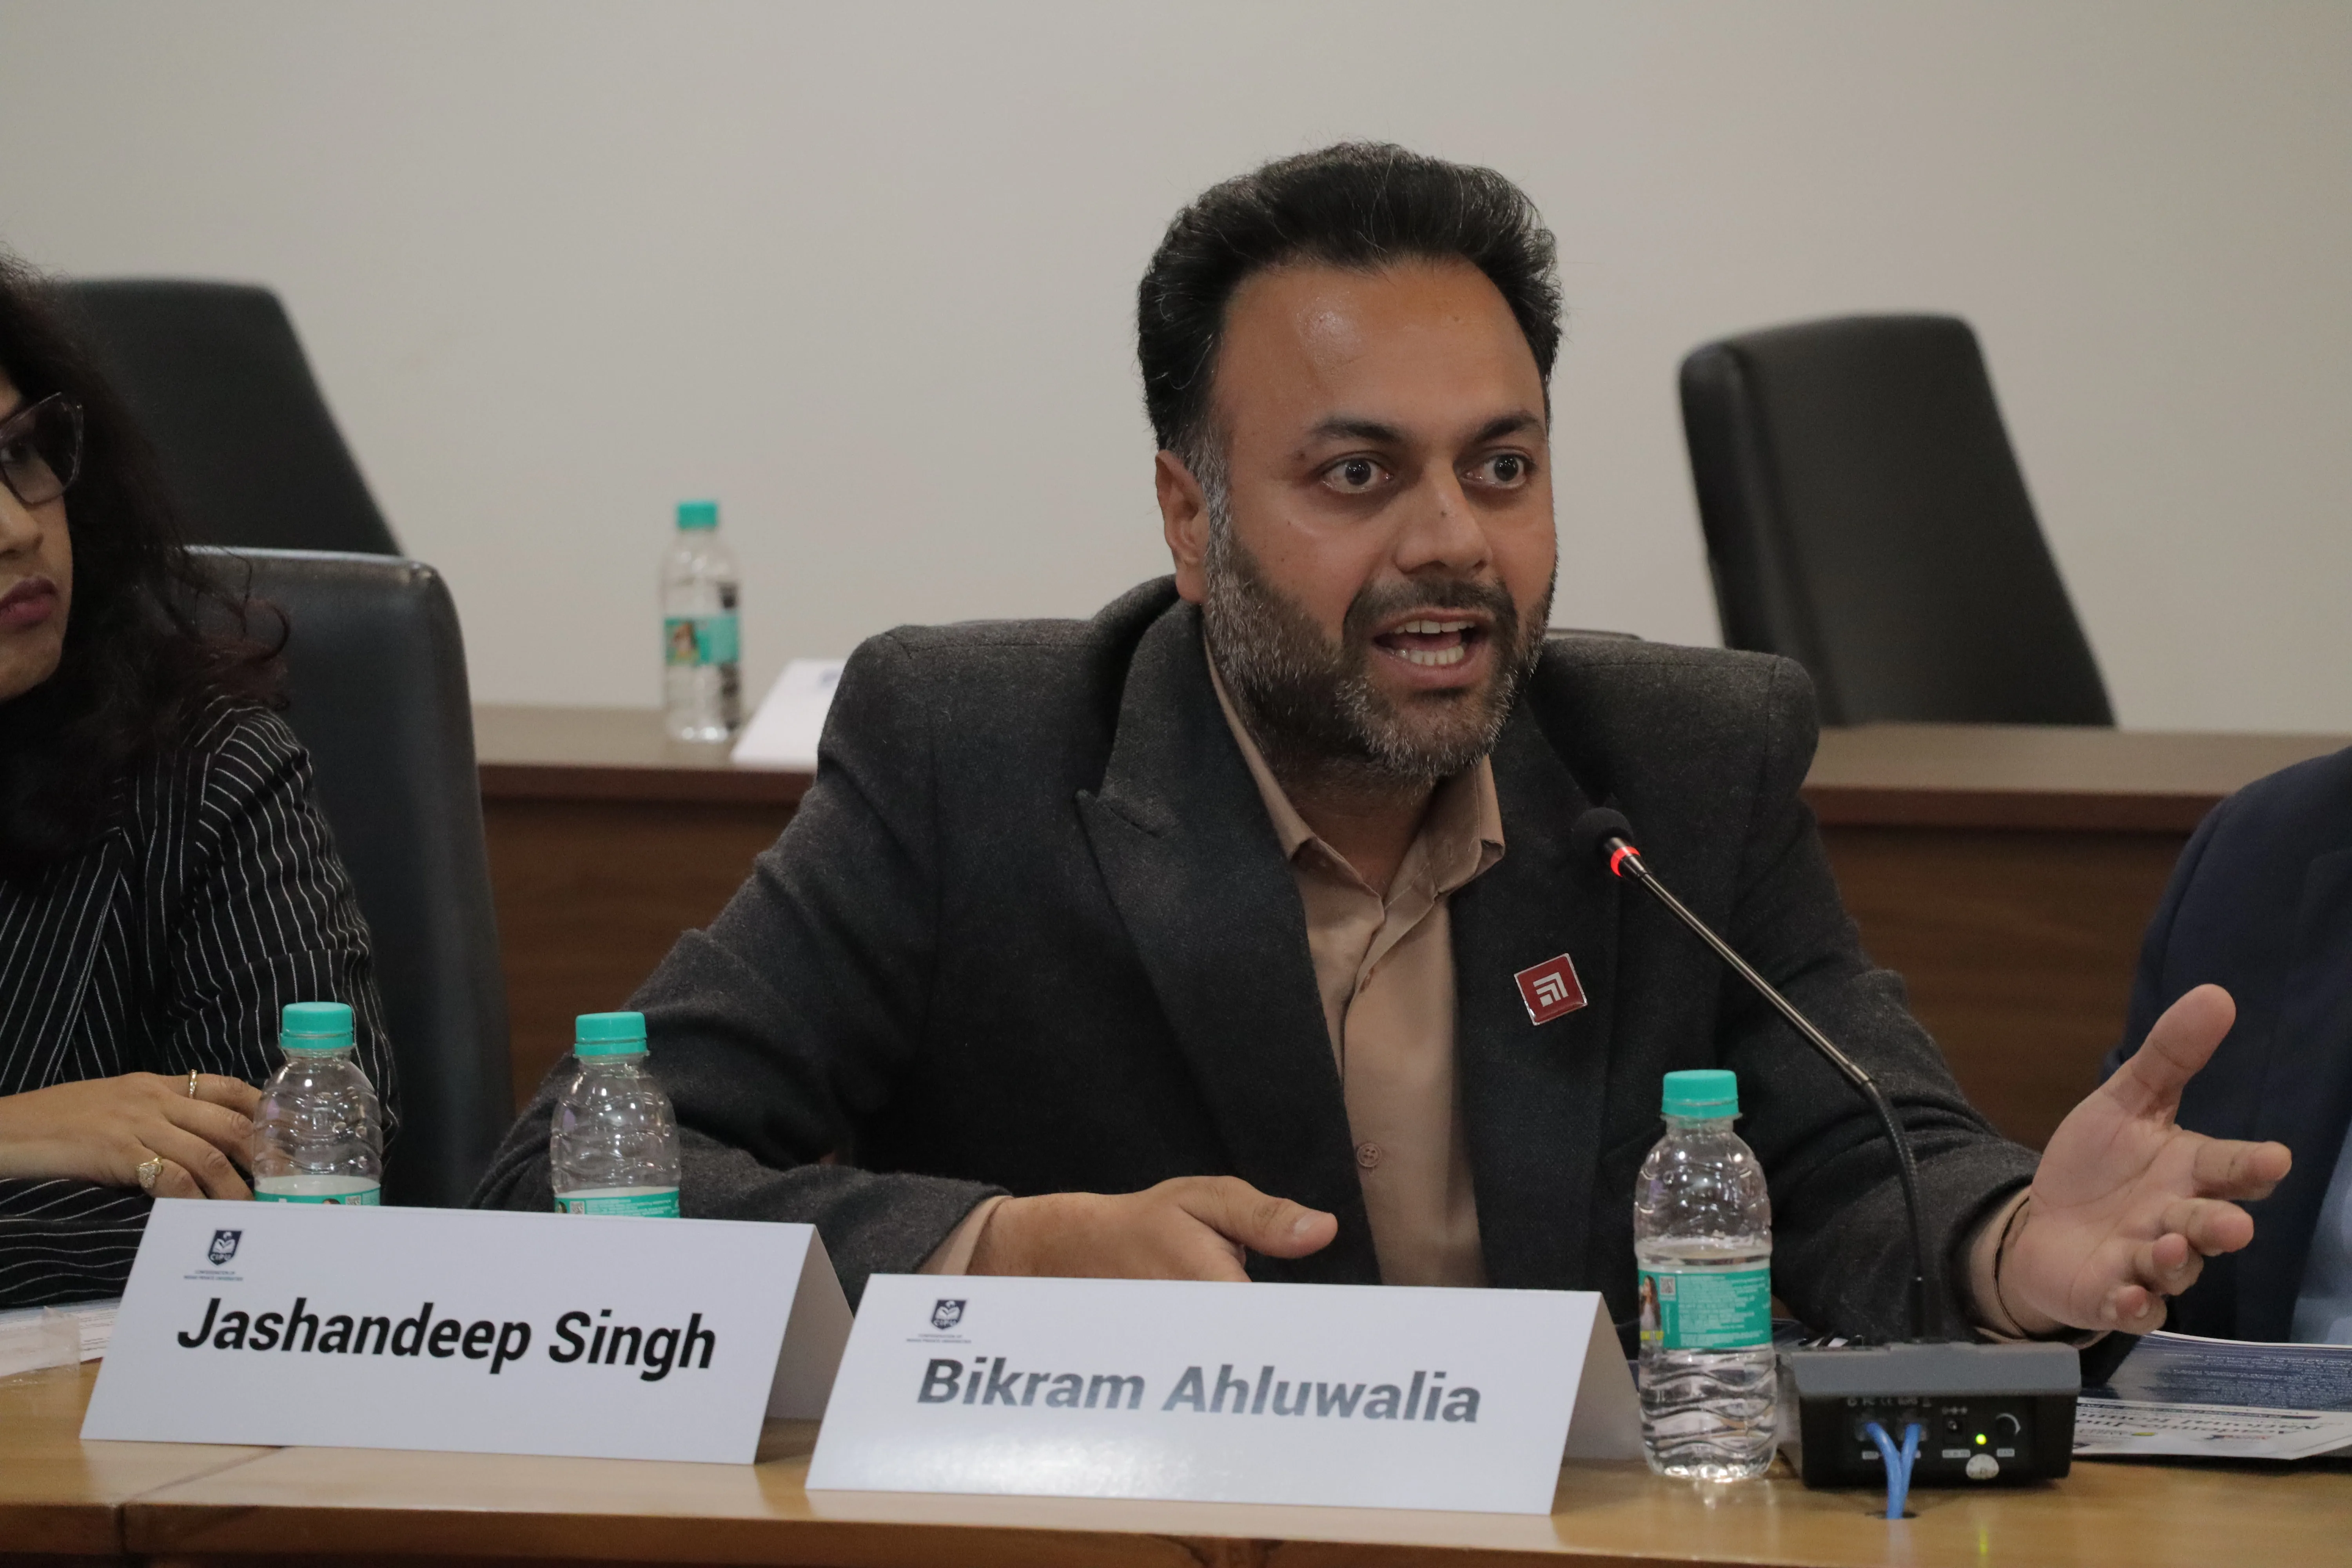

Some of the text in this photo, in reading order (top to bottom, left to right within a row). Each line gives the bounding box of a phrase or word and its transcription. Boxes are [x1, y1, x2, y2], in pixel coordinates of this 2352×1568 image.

[178, 1297, 715, 1382] Jashandeep Singh
[917, 1356, 1481, 1423] Bikram Ahluwalia
